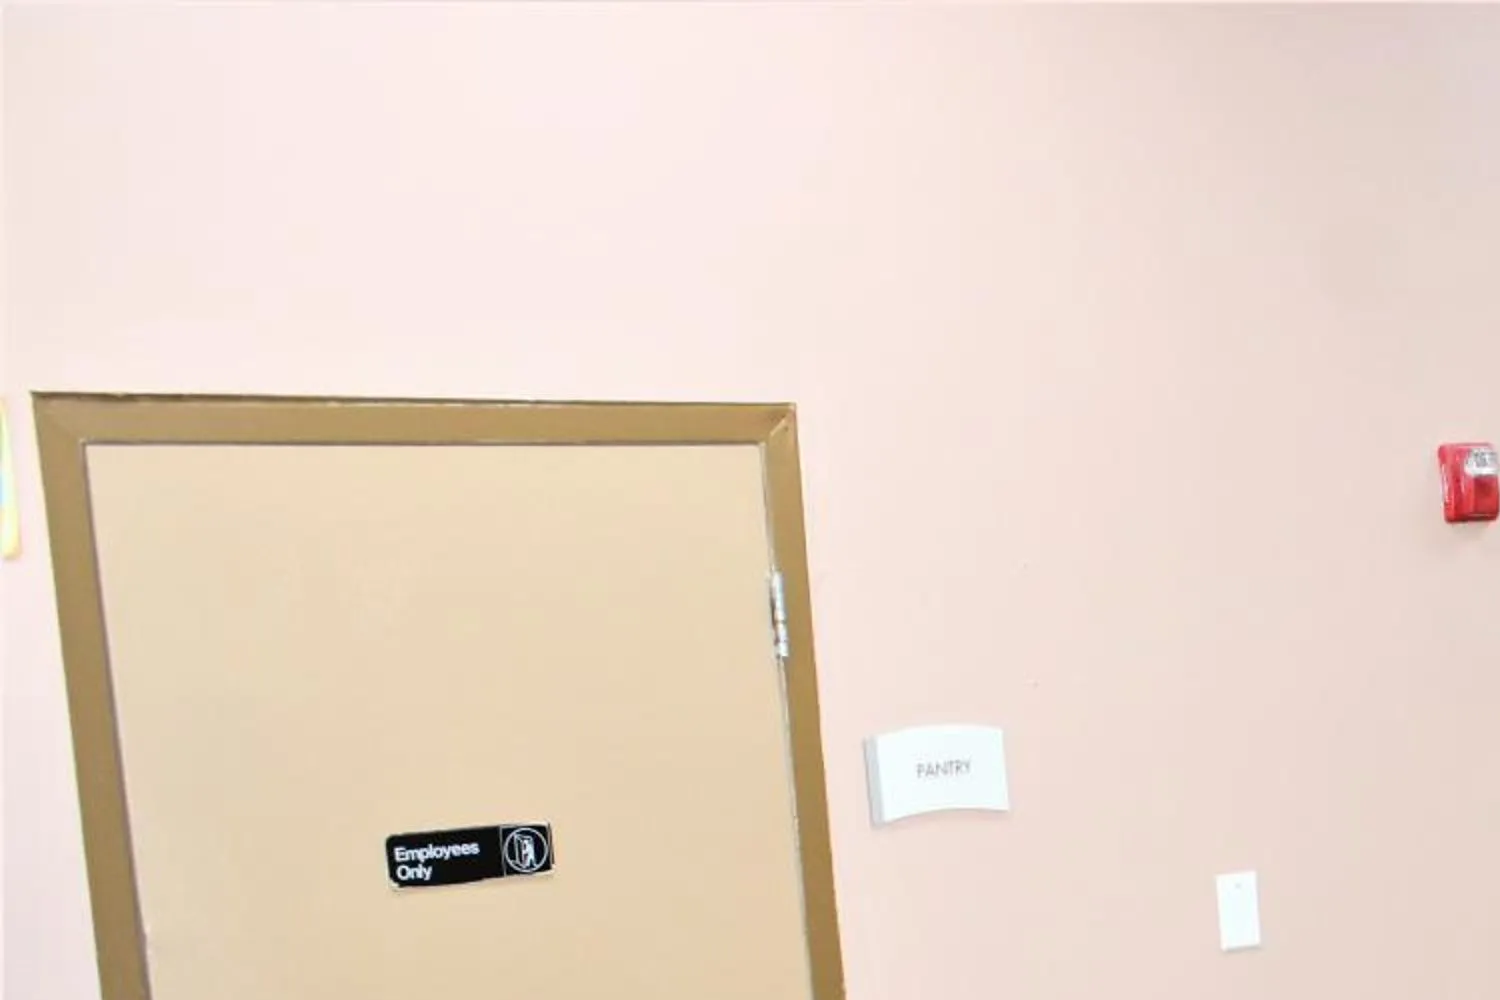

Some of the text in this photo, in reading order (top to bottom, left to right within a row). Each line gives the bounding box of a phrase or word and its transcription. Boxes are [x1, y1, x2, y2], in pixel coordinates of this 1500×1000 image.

[916, 758, 972, 779] PANTRY
[393, 842, 480, 862] Employees
[396, 865, 432, 881] Only
